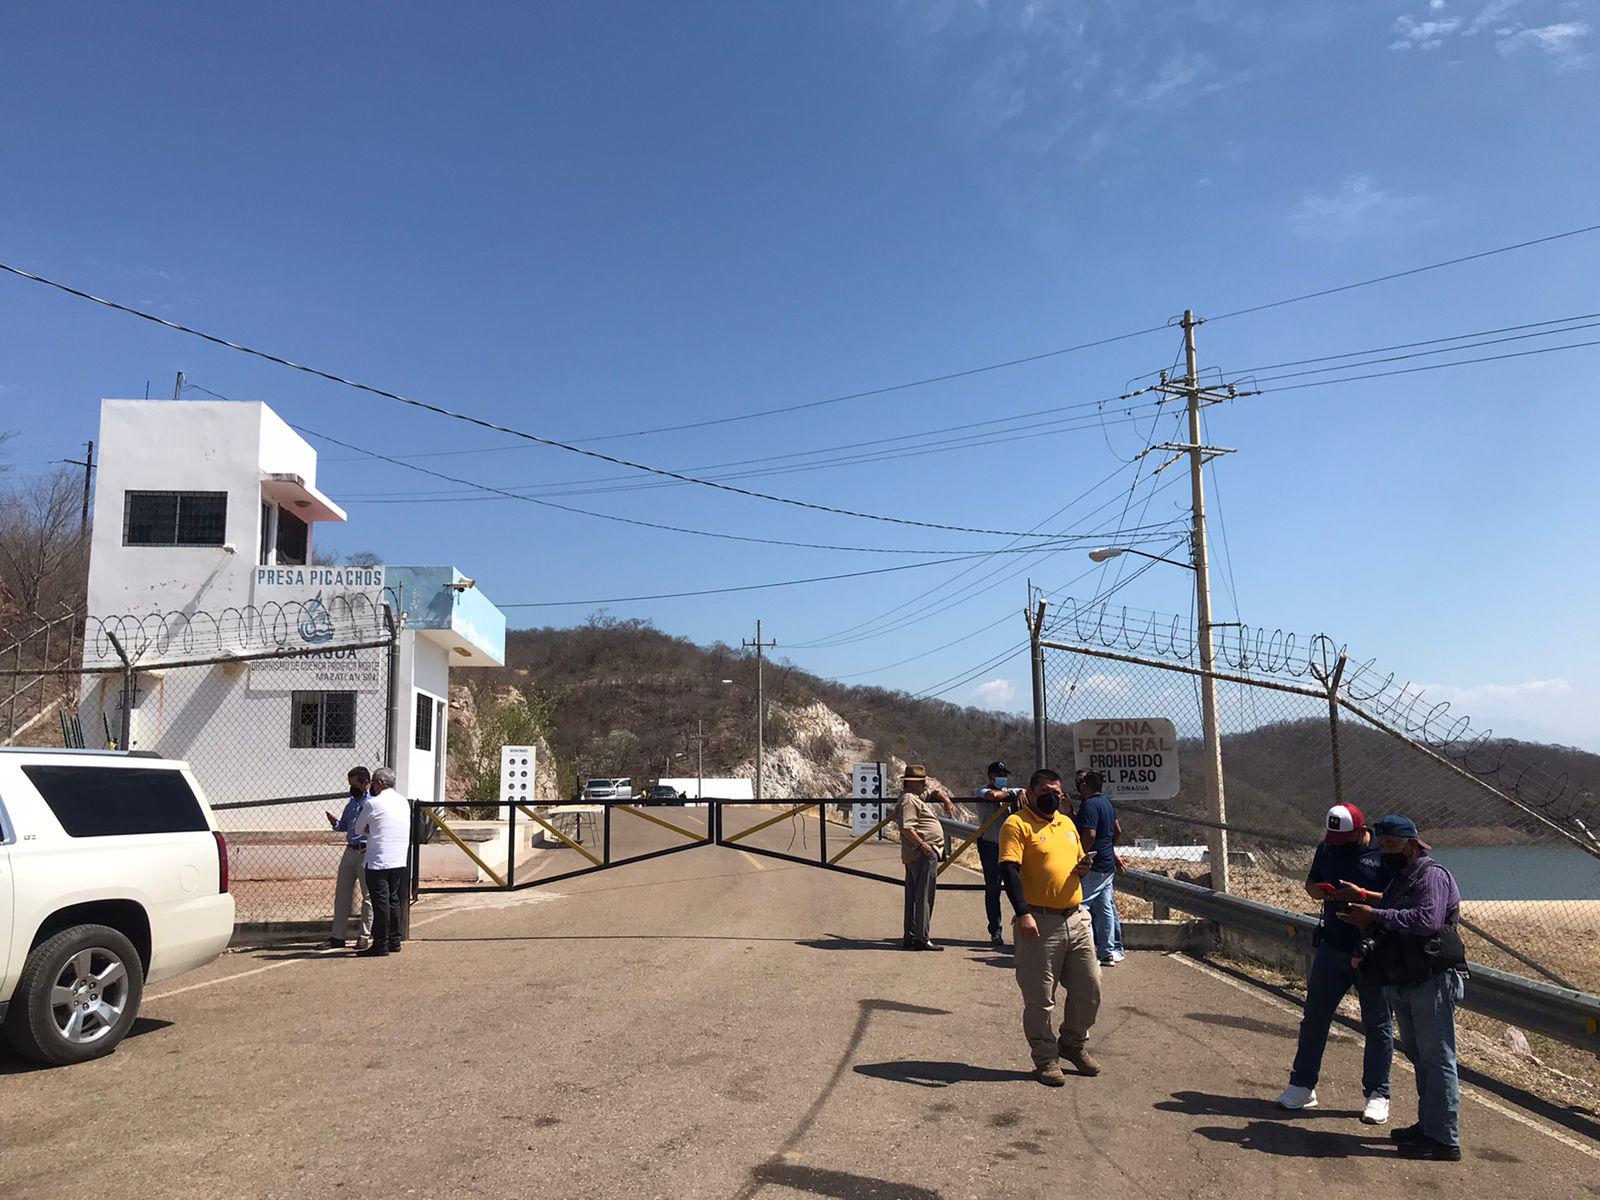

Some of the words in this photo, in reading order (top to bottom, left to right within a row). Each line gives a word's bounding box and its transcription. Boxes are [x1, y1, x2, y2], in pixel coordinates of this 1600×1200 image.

[257, 569, 305, 585] PRESA
[309, 570, 382, 586] PICACHOS
[1095, 720, 1156, 736] ZONA
[1078, 737, 1173, 753] FEDERAL
[1089, 753, 1163, 768] PROHIBIDO
[1099, 769, 1116, 783] EL
[1119, 769, 1157, 783] PASO
